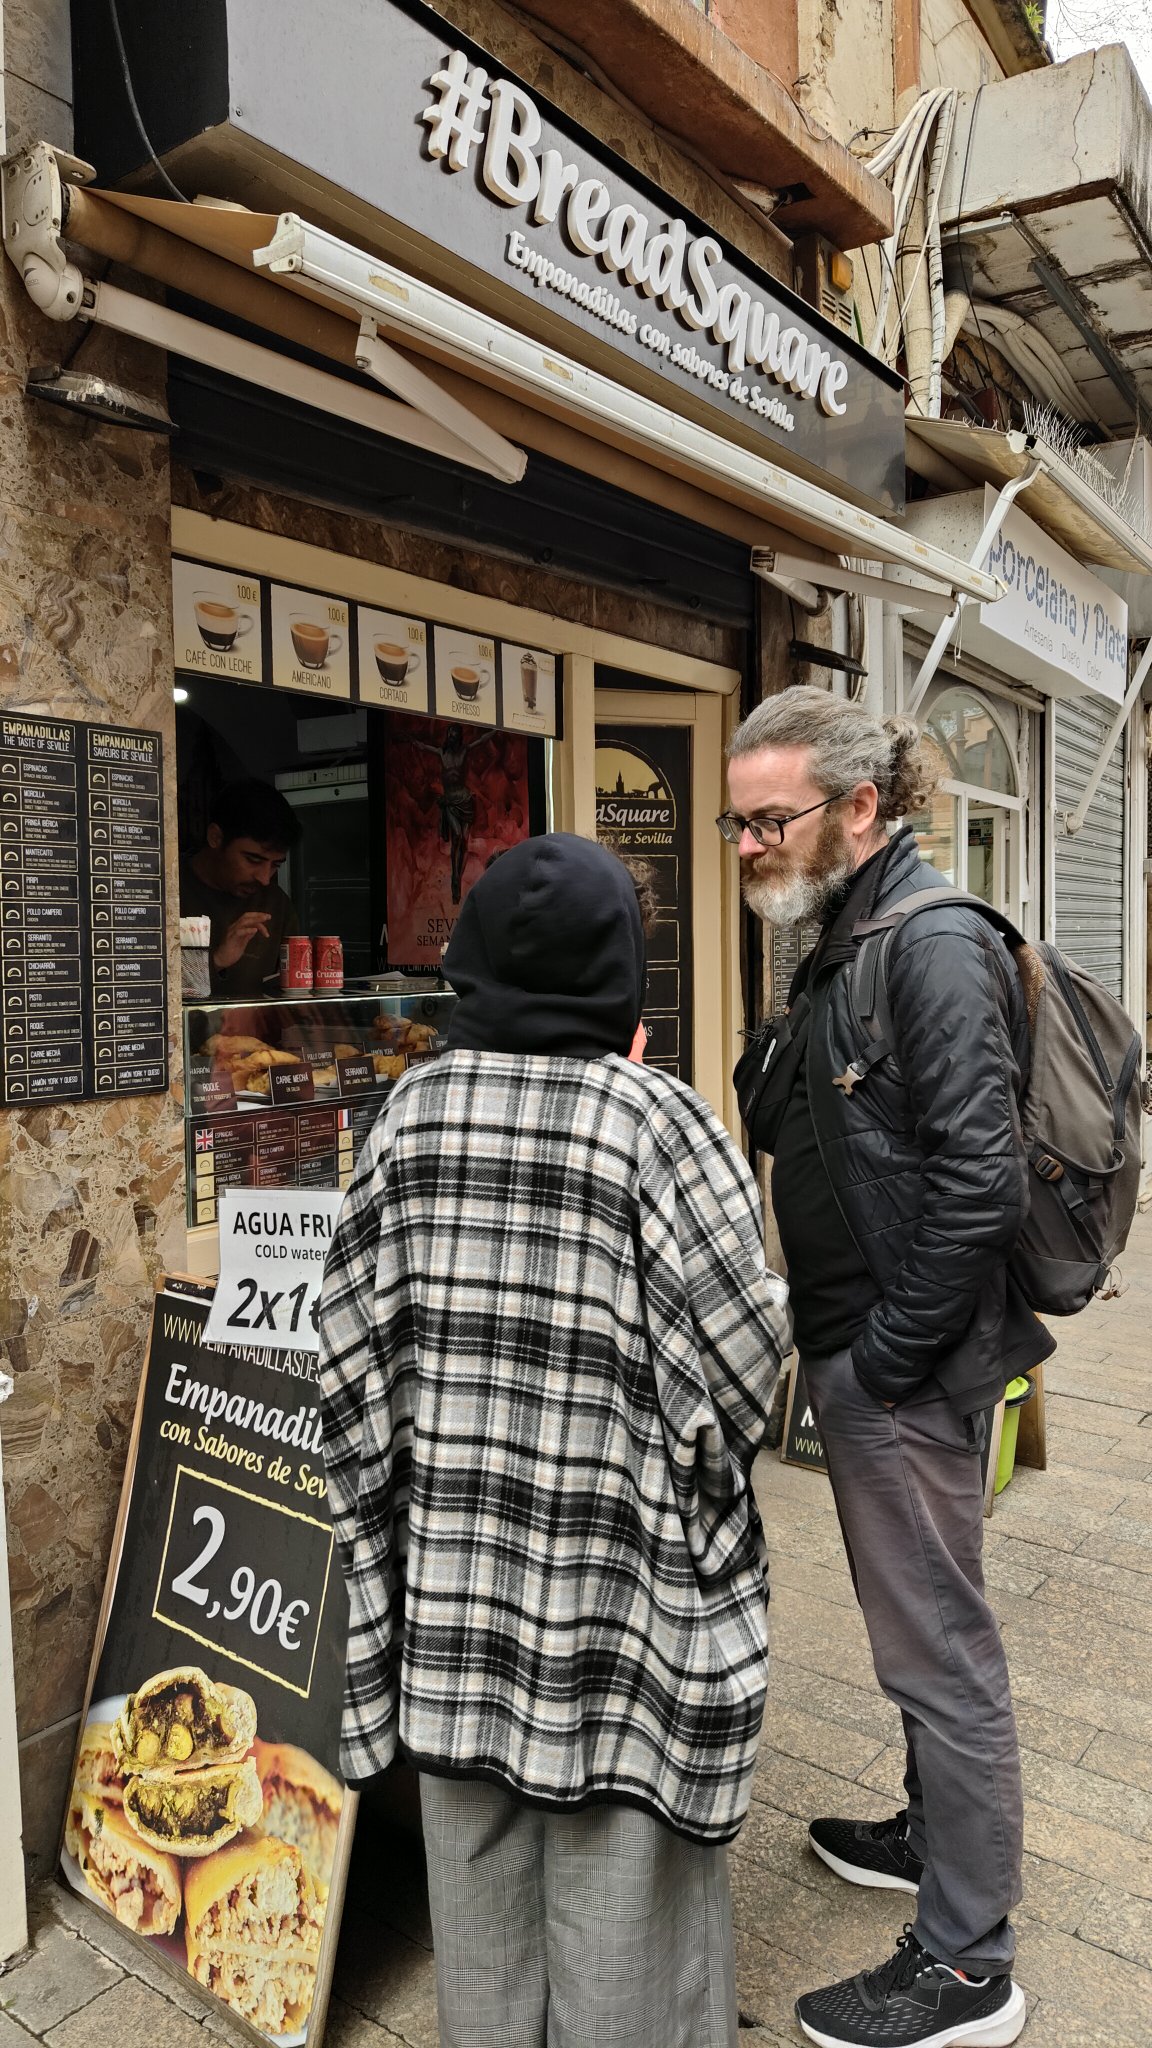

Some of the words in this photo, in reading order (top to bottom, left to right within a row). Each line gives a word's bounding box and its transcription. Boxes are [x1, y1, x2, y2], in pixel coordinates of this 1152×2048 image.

[423, 49, 848, 416] #BreadSquare
[507, 230, 637, 335] Empanadillas
[639, 324, 671, 356] con
[670, 343, 730, 391] sabores
[729, 376, 749, 404] de
[748, 385, 795, 432] Sevilla
[988, 528, 1077, 638] Porcelana
[1093, 603, 1127, 672] Plata
[185, 649, 207, 666] CAFÉ
[210, 653, 227, 670] CON
[229, 657, 253, 675] LECHE
[291, 670, 332, 689] AMERICANO
[379, 686, 408, 704] CORTADO
[451, 701, 481, 717] EXPRESSO
[2, 721, 71, 742] EMPANADILLAS
[3, 735, 16, 746] THE
[17, 736, 36, 748] TASTE
[37, 739, 45, 749] OF
[47, 740, 70, 752] SEVILLE
[93, 733, 153, 753] EMPANADILLAS
[93, 747, 120, 759] SAVEURS
[121, 750, 129, 760] DE
[131, 751, 153, 763] SEVILLE
[620, 832, 632, 844] de
[634, 832, 673, 844] Sevilla
[27, 907, 41, 916] POLLO
[42, 908, 62, 916] CAMPERO
[427, 918, 458, 933] SEV
[31, 1050, 45, 1058] CARNE
[48, 1077, 59, 1085] YORK
[64, 1076, 78, 1084] QUESO
[202, 1082, 220, 1092] ROQUE
[276, 1076, 291, 1085] CARNE
[292, 1072, 309, 1083] MECHÁ
[233, 1211, 294, 1236] AGUA
[255, 1244, 287, 1259] COLD
[291, 1248, 328, 1261] water
[160, 1420, 191, 1446] con
[194, 1425, 264, 1474] Sabores
[267, 1456, 292, 1485] de
[171, 1505, 310, 1650] 2,90€
